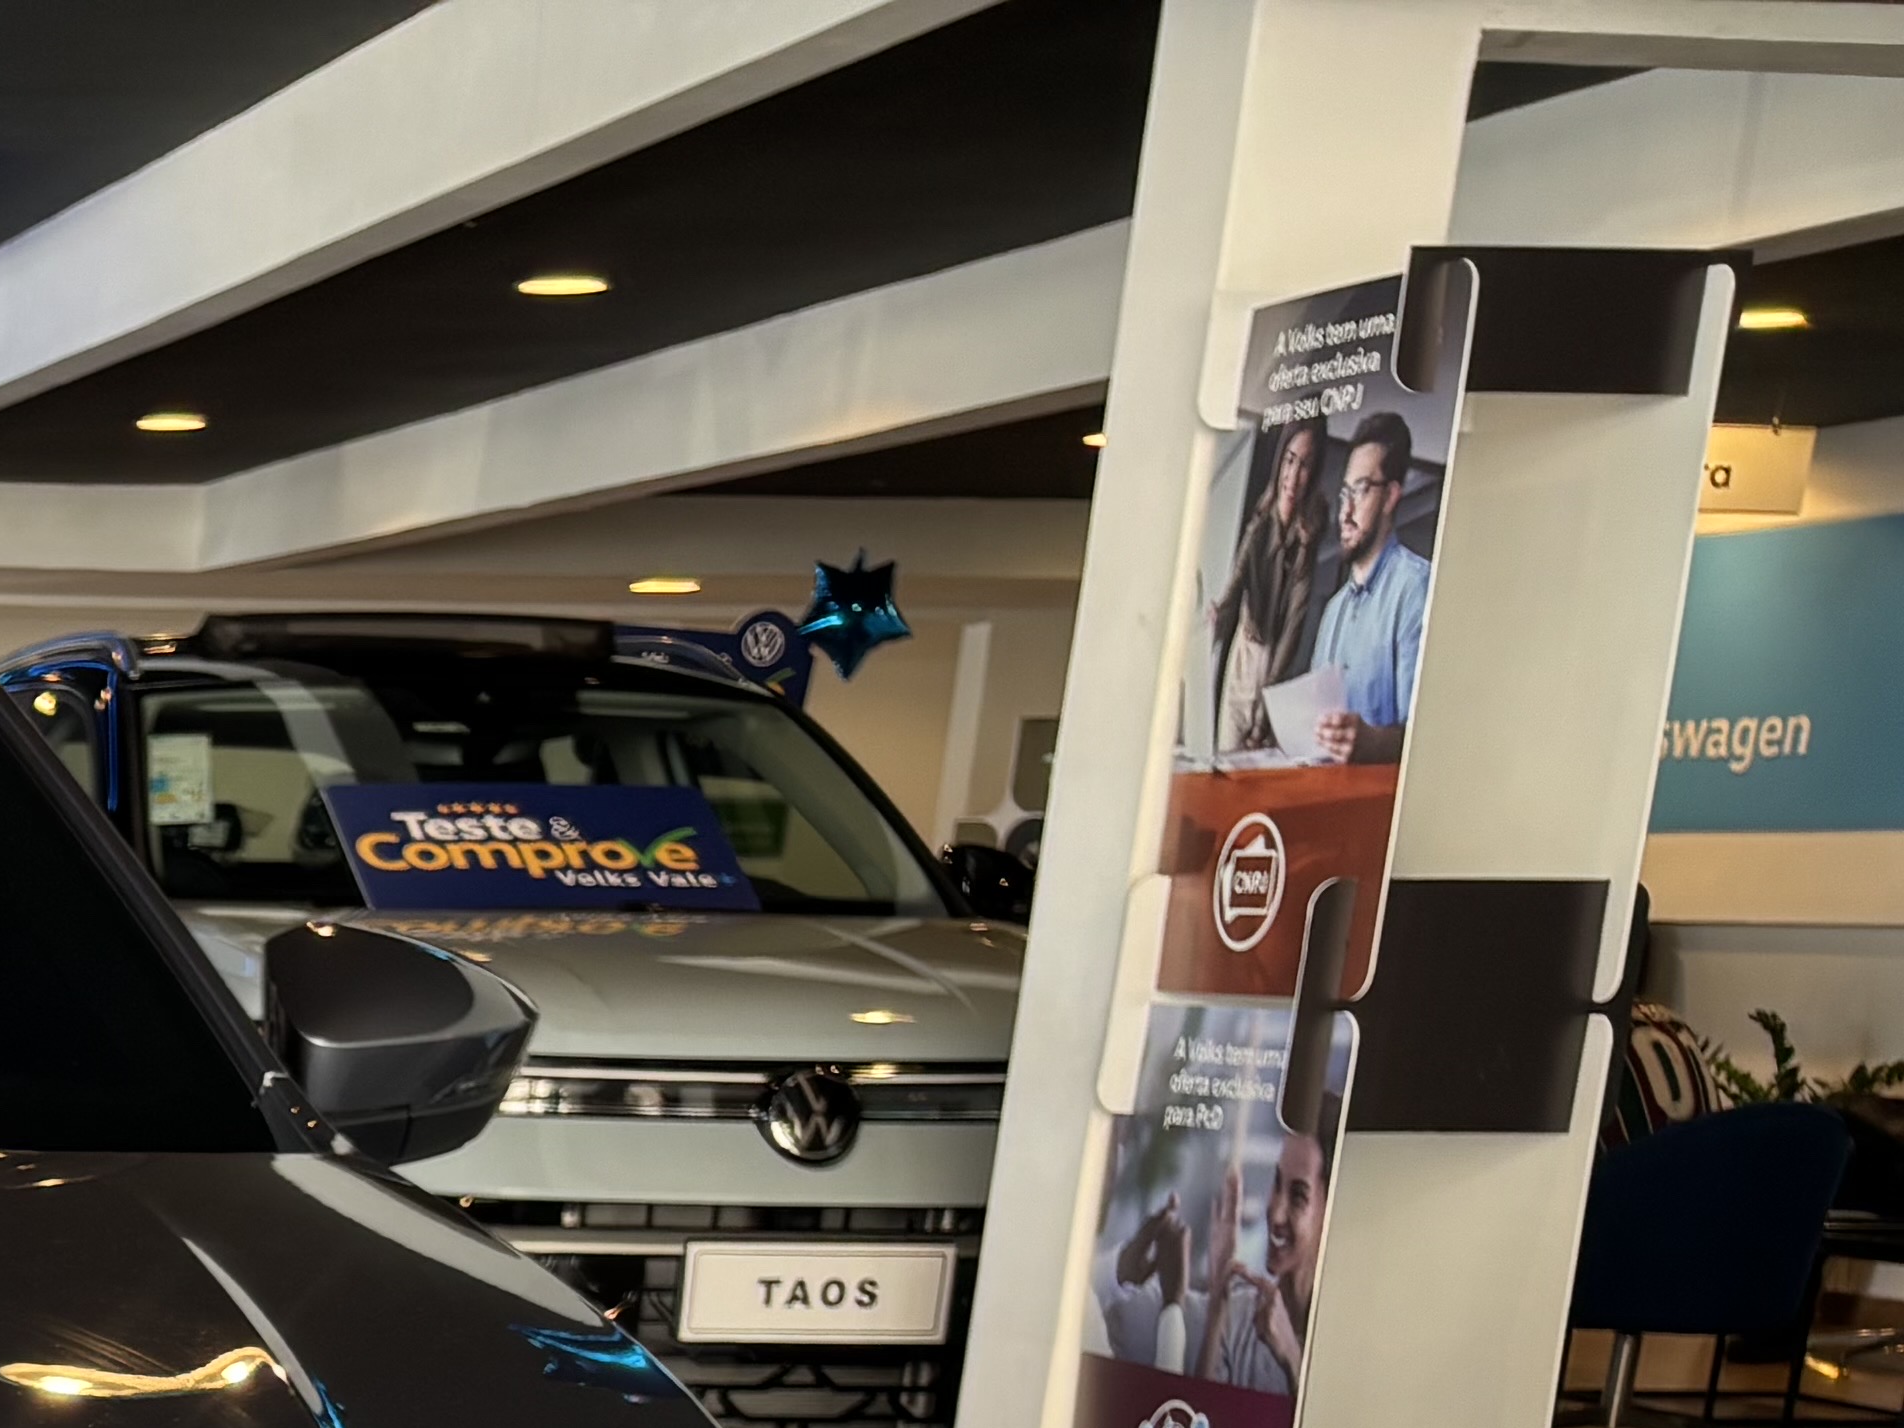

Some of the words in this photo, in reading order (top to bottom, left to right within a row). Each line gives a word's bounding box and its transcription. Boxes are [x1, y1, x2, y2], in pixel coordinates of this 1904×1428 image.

[1320, 382, 1365, 416] CNPJ
[390, 810, 542, 841] Teste
[355, 827, 699, 879] Comprove
[554, 869, 642, 888] Volks
[756, 1275, 882, 1309] TAOS
